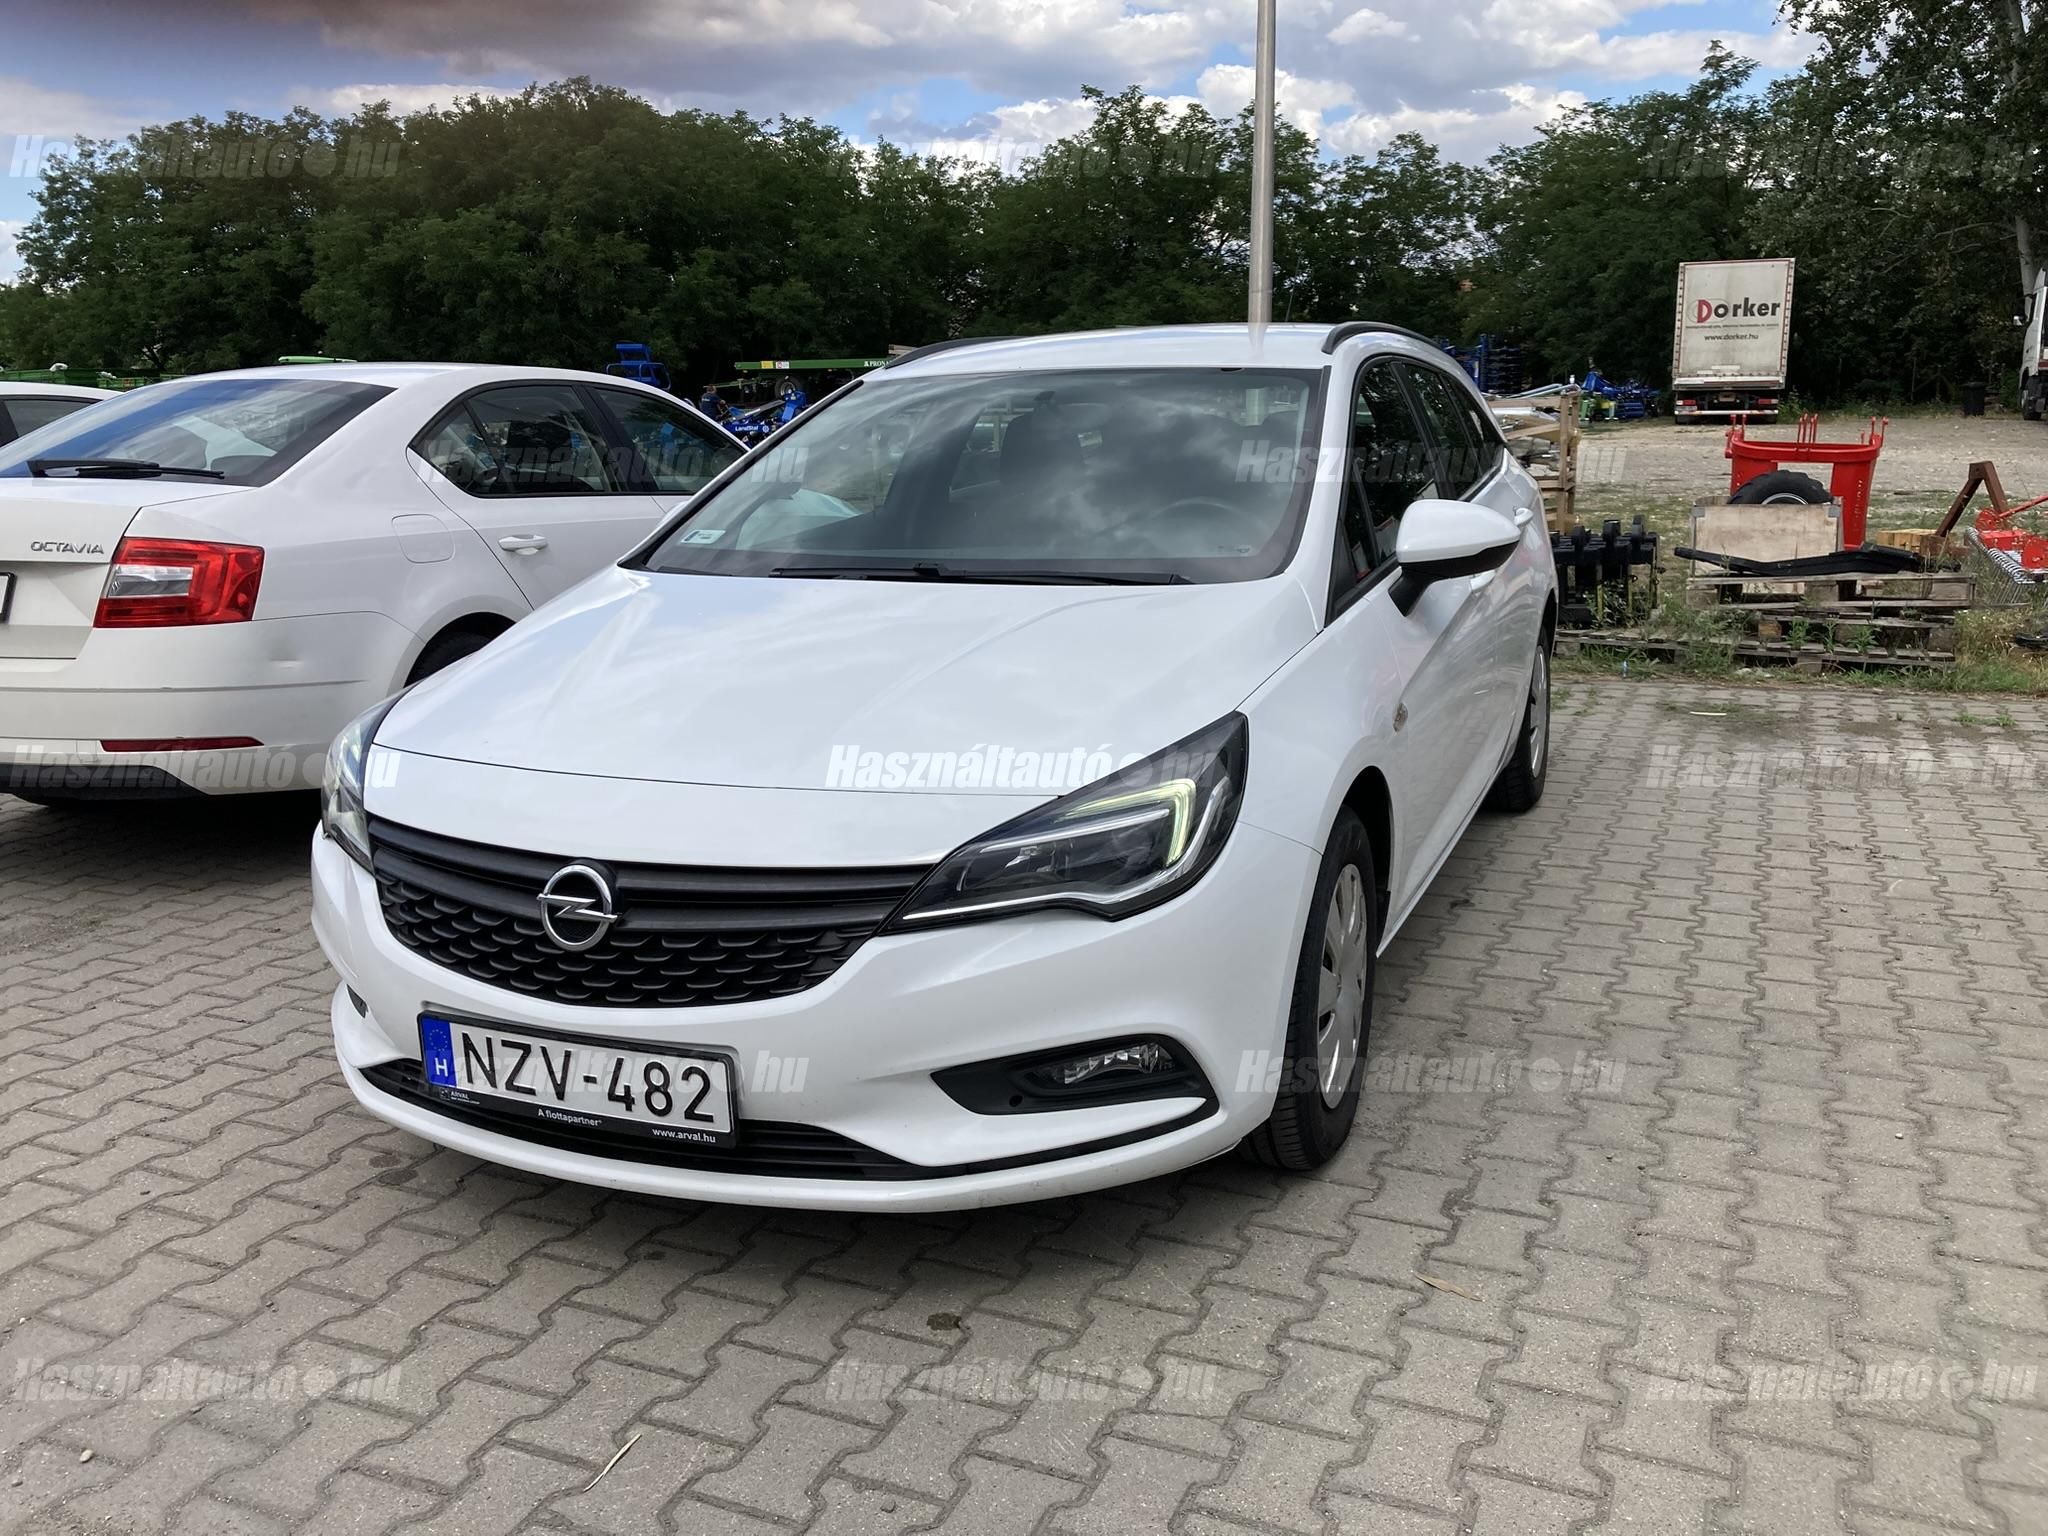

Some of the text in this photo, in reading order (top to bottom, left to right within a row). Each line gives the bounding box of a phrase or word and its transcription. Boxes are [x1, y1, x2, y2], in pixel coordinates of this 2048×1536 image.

[1697, 297, 1780, 323] Dorker
[1704, 332, 1759, 341] www.dorker.hu
[31, 541, 104, 554] OCTAVIA
[434, 1057, 449, 1077] H
[461, 1032, 715, 1124] NZV-482
[538, 1109, 545, 1117] A
[651, 1128, 716, 1143] www.arval.hu
